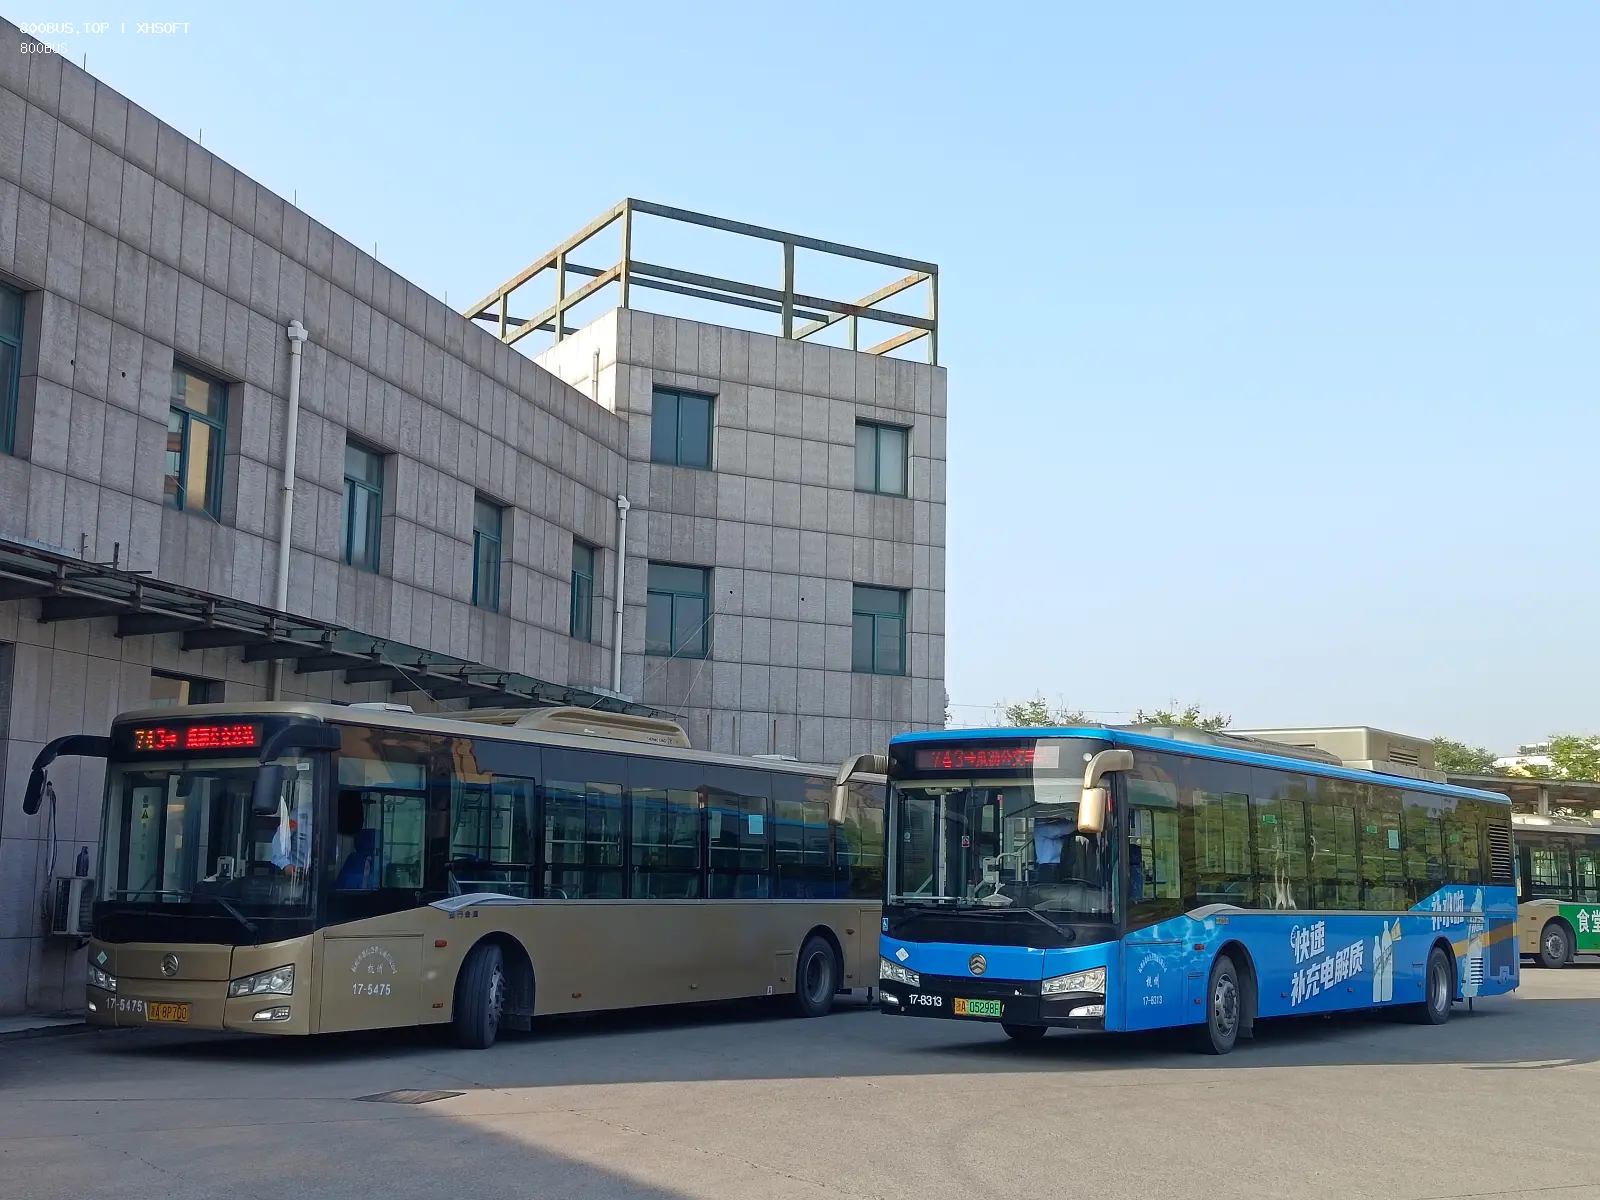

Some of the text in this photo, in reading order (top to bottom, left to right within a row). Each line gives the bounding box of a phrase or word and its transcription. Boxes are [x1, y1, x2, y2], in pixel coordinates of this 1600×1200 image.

[1576, 908, 1600, 933] 食堂
[1294, 920, 1325, 965] 快速
[1290, 939, 1364, 1007] 补充电解质
[352, 983, 391, 996] 17-5475
[106, 998, 143, 1013] 17-5475
[908, 994, 942, 1007] 17-8313
[1142, 995, 1163, 1005] 17-8313
